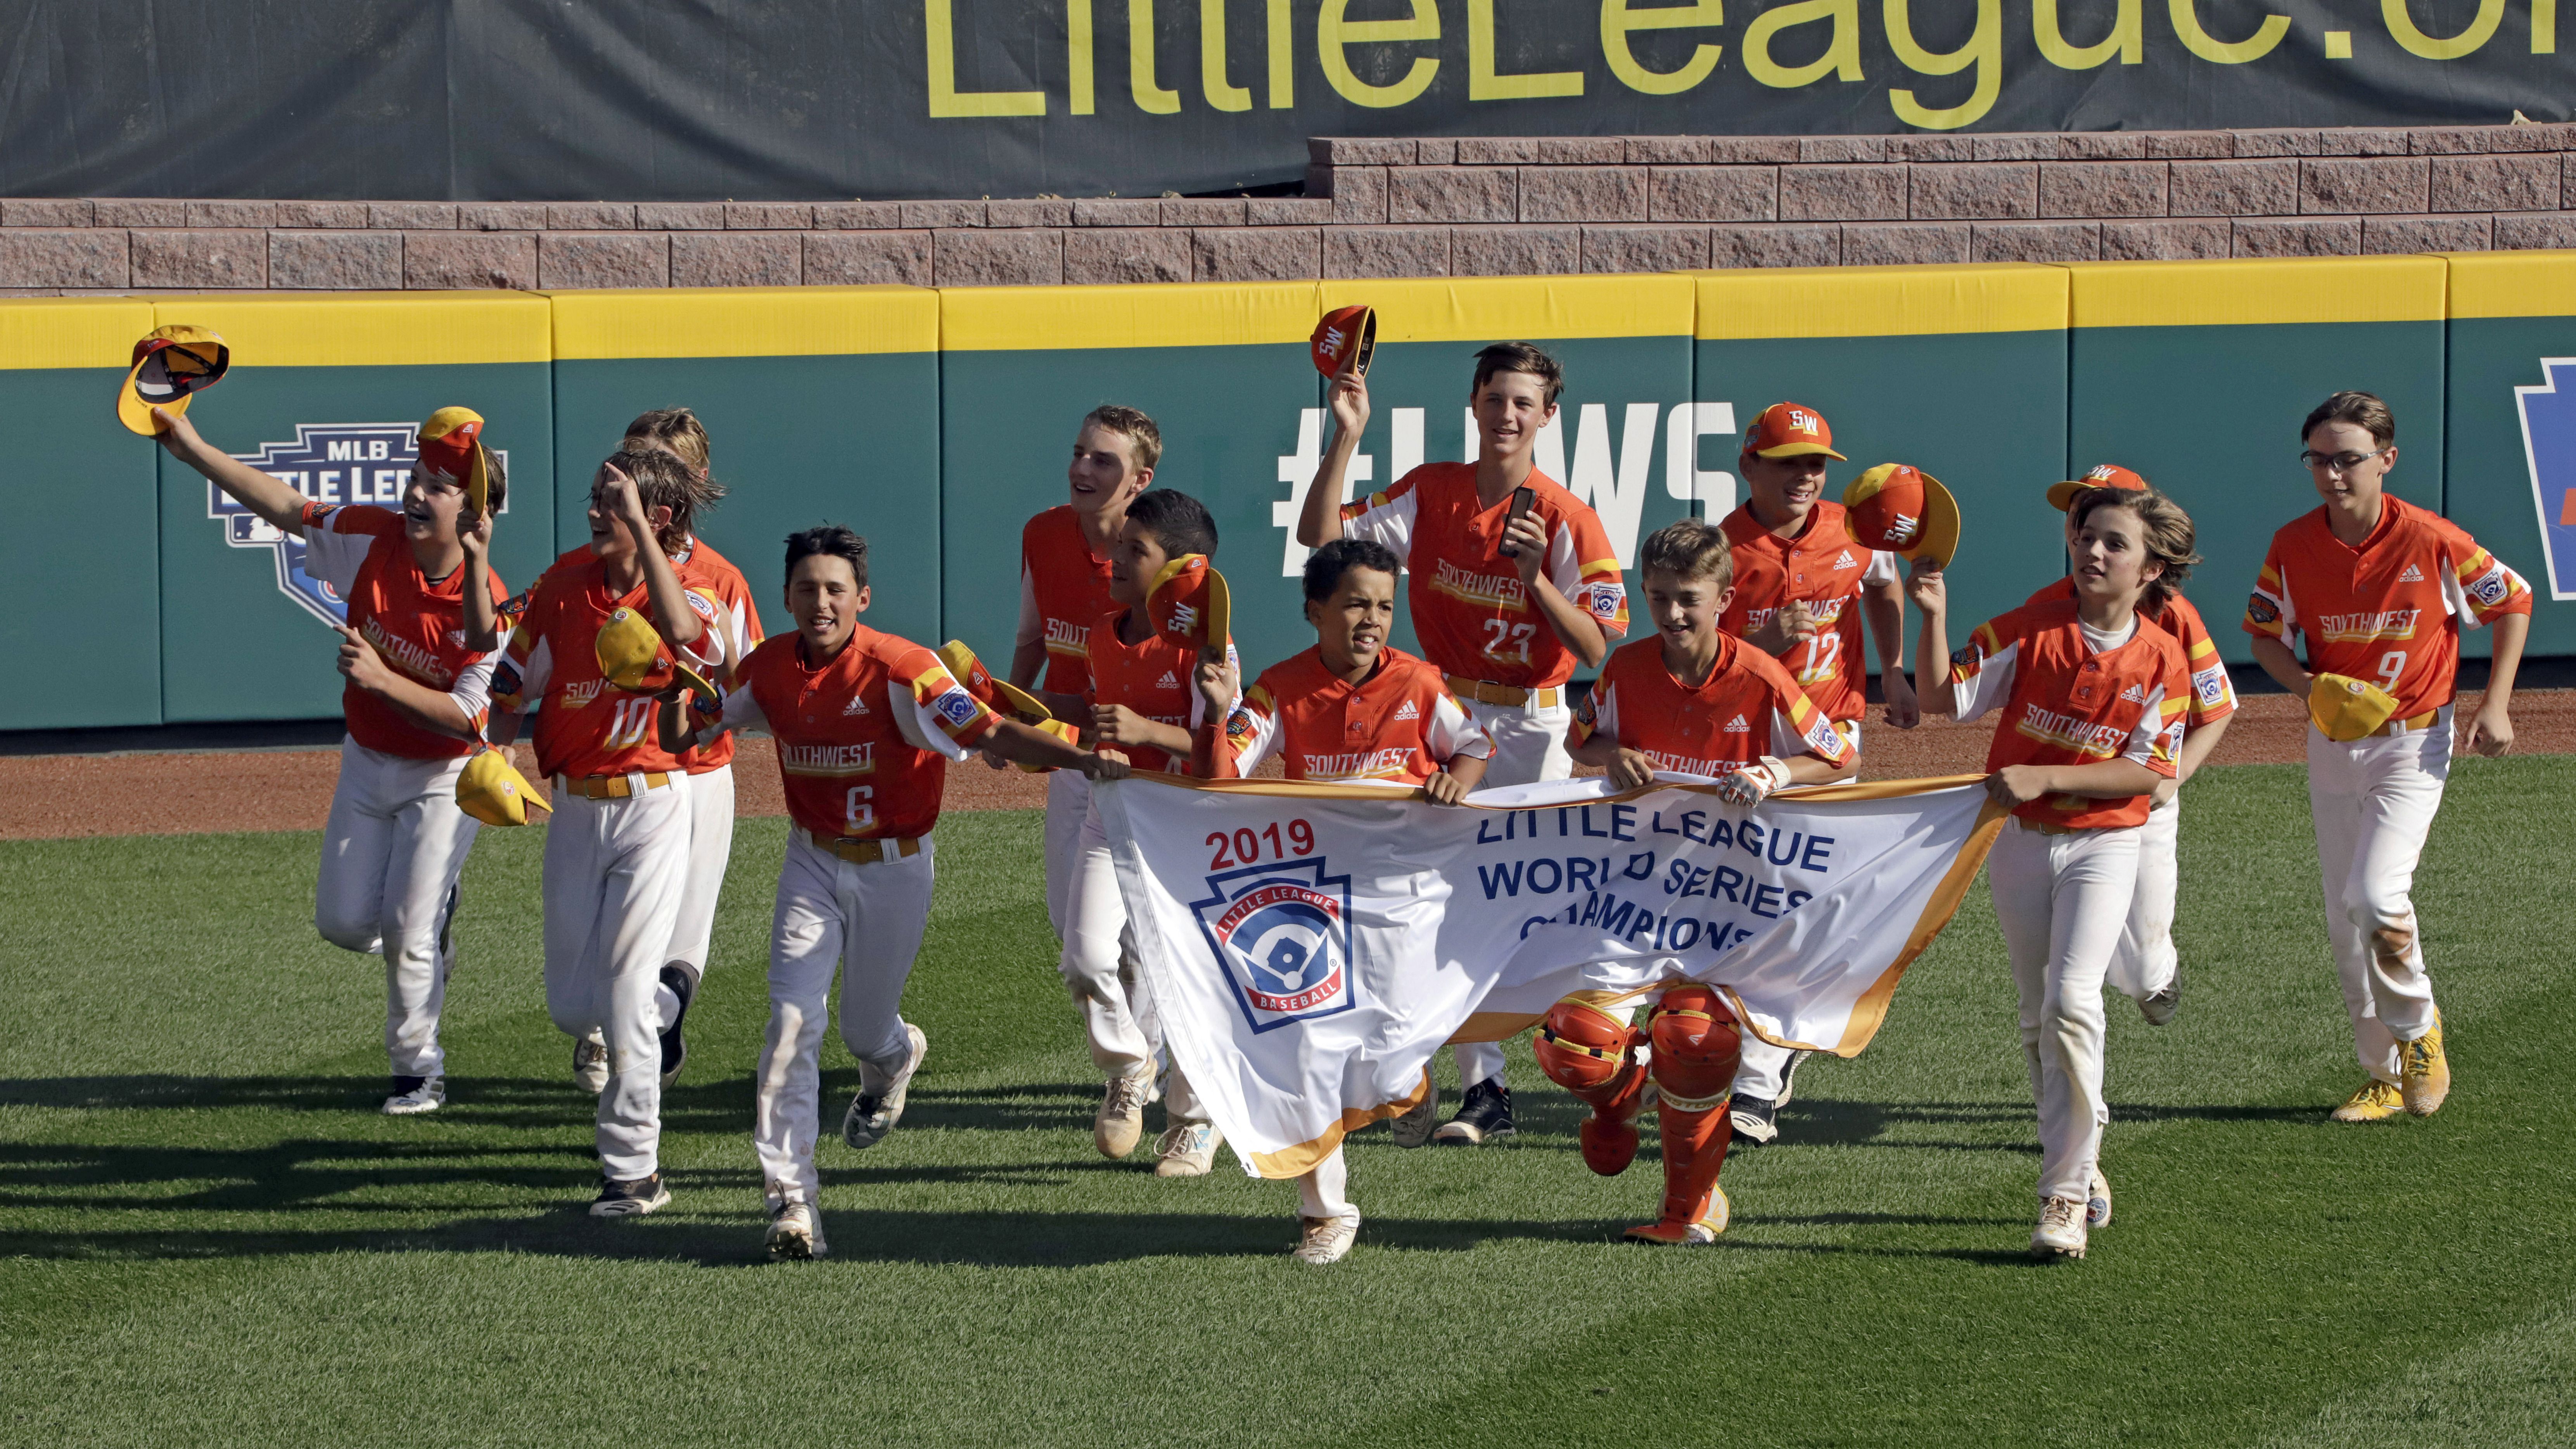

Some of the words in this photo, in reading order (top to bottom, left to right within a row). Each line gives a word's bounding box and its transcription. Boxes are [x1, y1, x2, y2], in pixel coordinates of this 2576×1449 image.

[1788, 410, 1817, 432] SW
[328, 440, 389, 461] MLB
[1883, 513, 1917, 543] SW
[1833, 560, 1857, 570] adidas
[1168, 602, 1195, 635] SW
[2319, 609, 2421, 637] SOUTHWEST
[1483, 618, 1537, 663] 23
[1803, 631, 1841, 682] 12
[2372, 651, 2407, 693] 9
[843, 707, 870, 716] adidas
[2121, 692, 2146, 705] adidas
[609, 697, 652, 746] 10
[1394, 712, 1420, 720] adidas
[1724, 724, 1751, 732] adidas
[2023, 703, 2128, 751] SOUTHWEST
[1303, 748, 1417, 776] SOUTHWEST
[846, 786, 873, 829] 6
[1205, 819, 1315, 871] 2019
[1477, 804, 1637, 845] LITTLE
[1652, 811, 1835, 873] LEAGUE
[1219, 893, 1264, 935] LITTLE
[1272, 889, 1334, 910] LEAGUE
[1260, 982, 1336, 1009] BASEBALL
